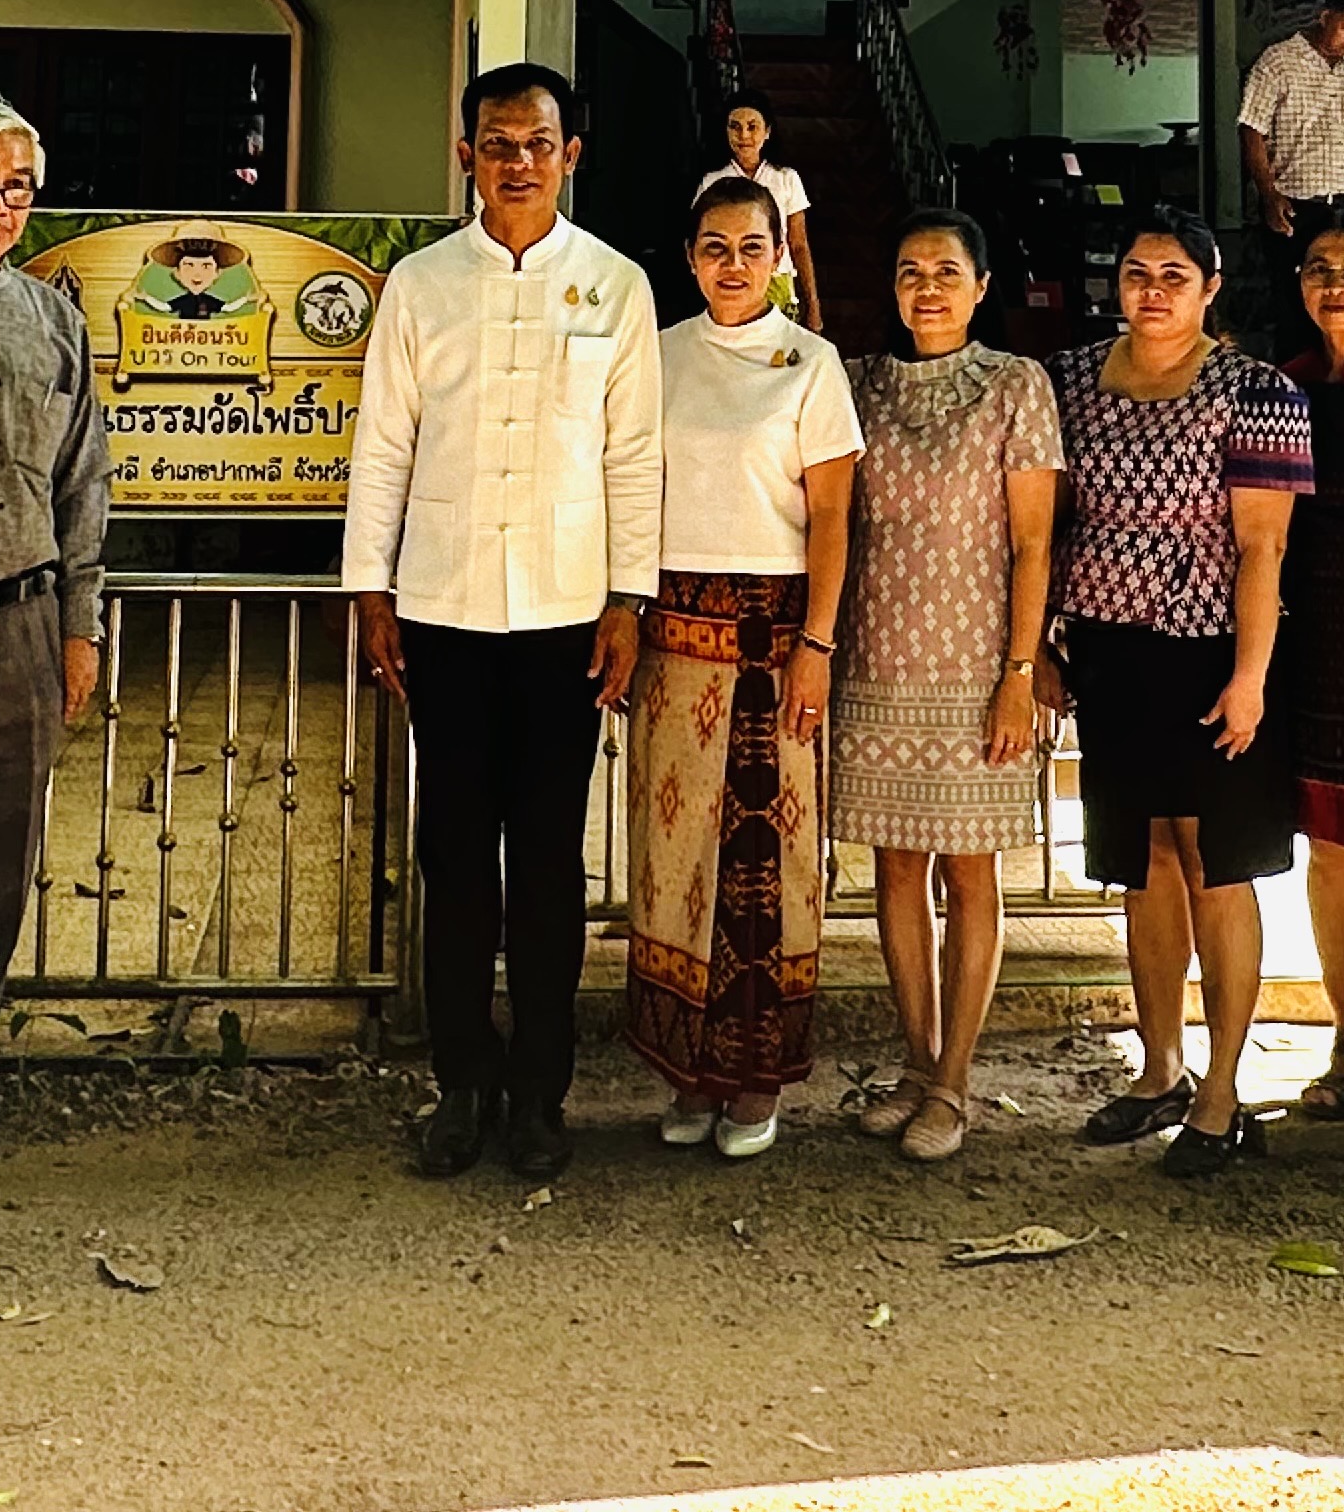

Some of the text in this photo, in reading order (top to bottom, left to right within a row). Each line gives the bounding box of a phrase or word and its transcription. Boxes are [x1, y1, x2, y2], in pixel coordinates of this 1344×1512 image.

[141, 322, 249, 347] ยินดีต้อนรับ
[180, 352, 208, 367] On
[217, 352, 257, 367] Tour
[150, 455, 283, 482] อำเภอปากพลี
